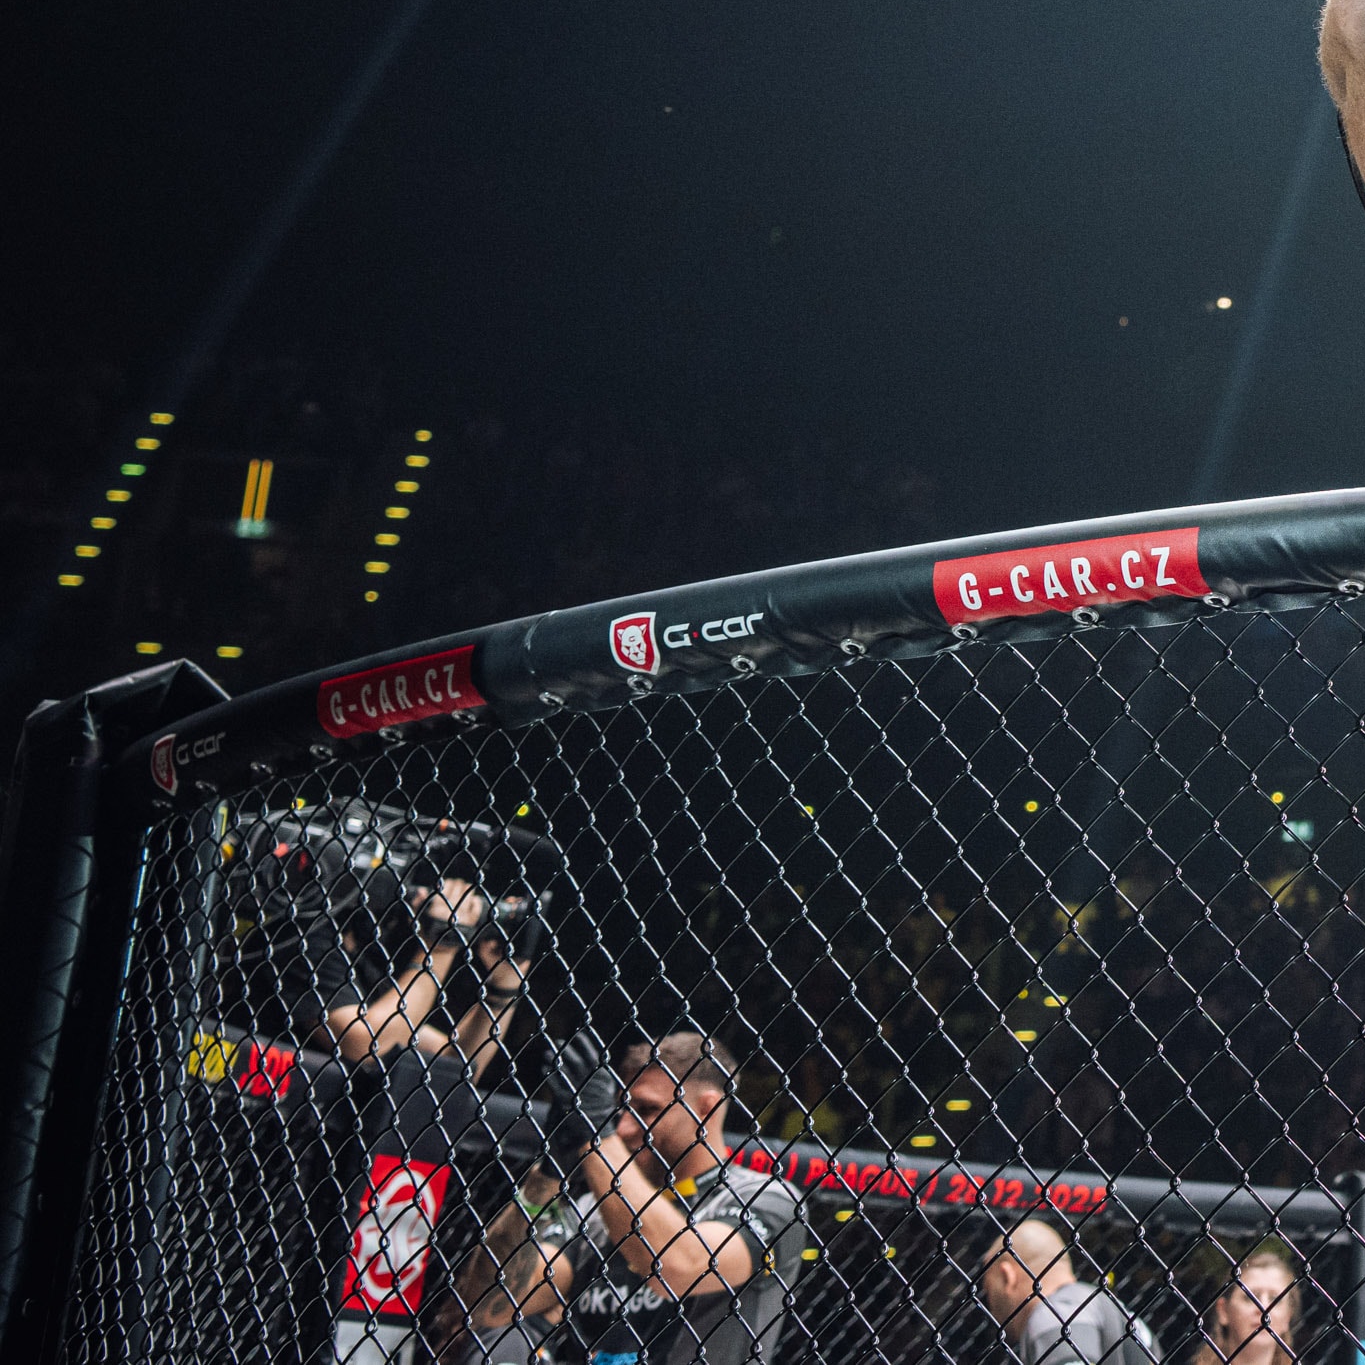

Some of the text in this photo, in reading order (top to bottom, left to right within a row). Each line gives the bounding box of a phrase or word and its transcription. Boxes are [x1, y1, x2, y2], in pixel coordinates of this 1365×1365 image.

[958, 546, 1177, 611] G-CAR.CZ
[329, 663, 462, 725] G-CAR.CZ
[579, 1283, 673, 1314] OKTAGO
